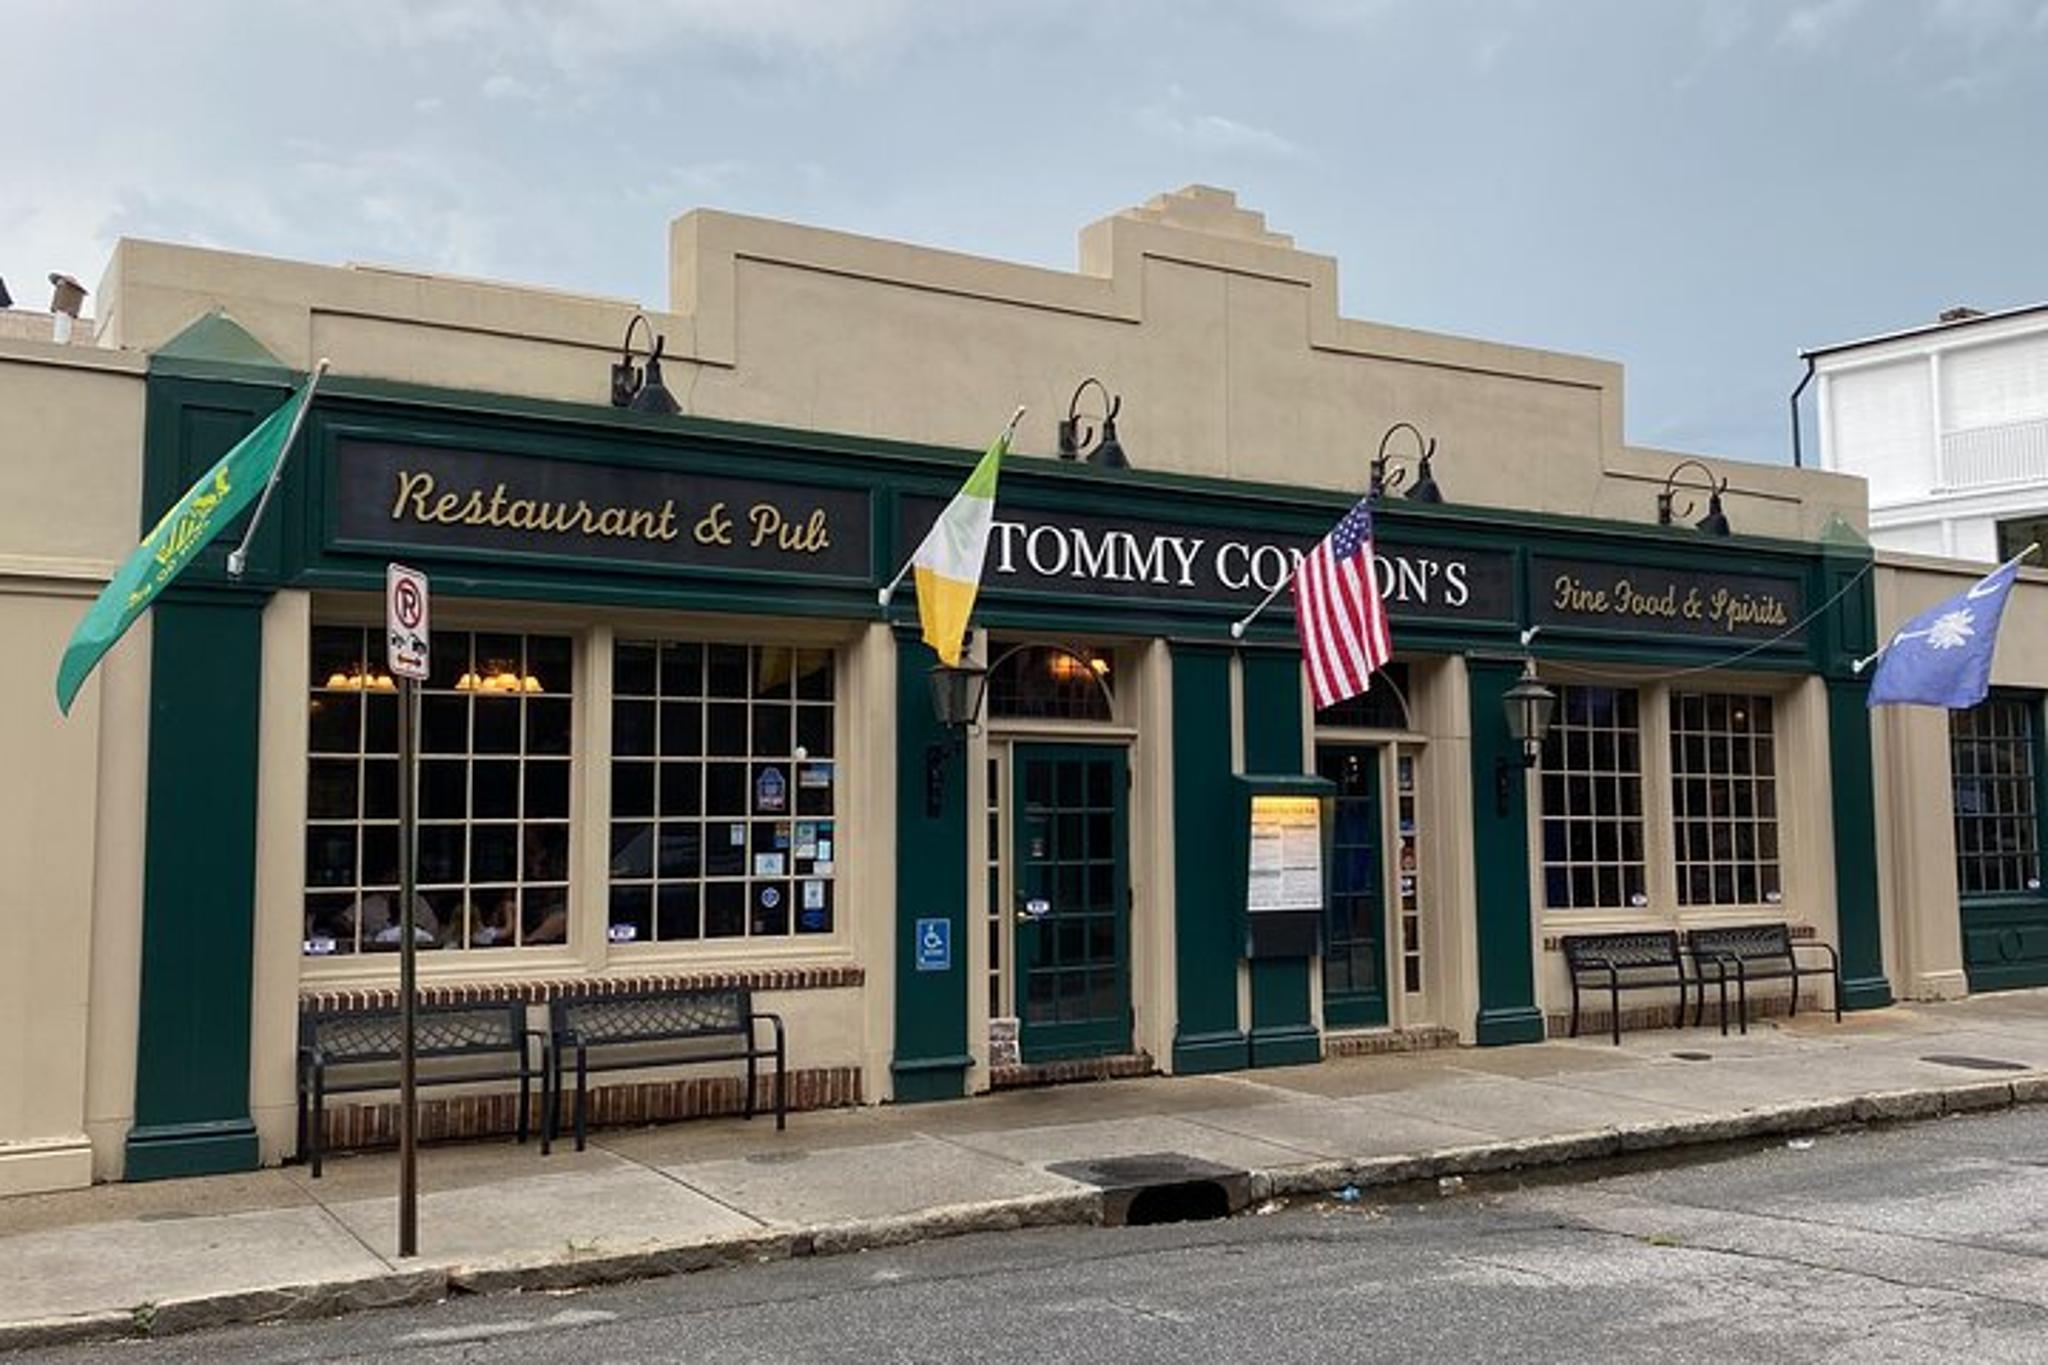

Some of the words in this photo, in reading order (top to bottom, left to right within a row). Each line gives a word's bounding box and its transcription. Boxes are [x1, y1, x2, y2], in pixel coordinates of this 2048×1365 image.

[392, 471, 678, 540] Restaurant
[694, 502, 733, 544] &
[749, 504, 829, 551] Pub
[990, 521, 1204, 586] TOMMY
[1215, 542, 1469, 606] COON'S
[1554, 575, 1609, 613] Fine
[1614, 580, 1677, 617] Food
[1682, 588, 1702, 618] &
[1708, 588, 1787, 631] Spirits
